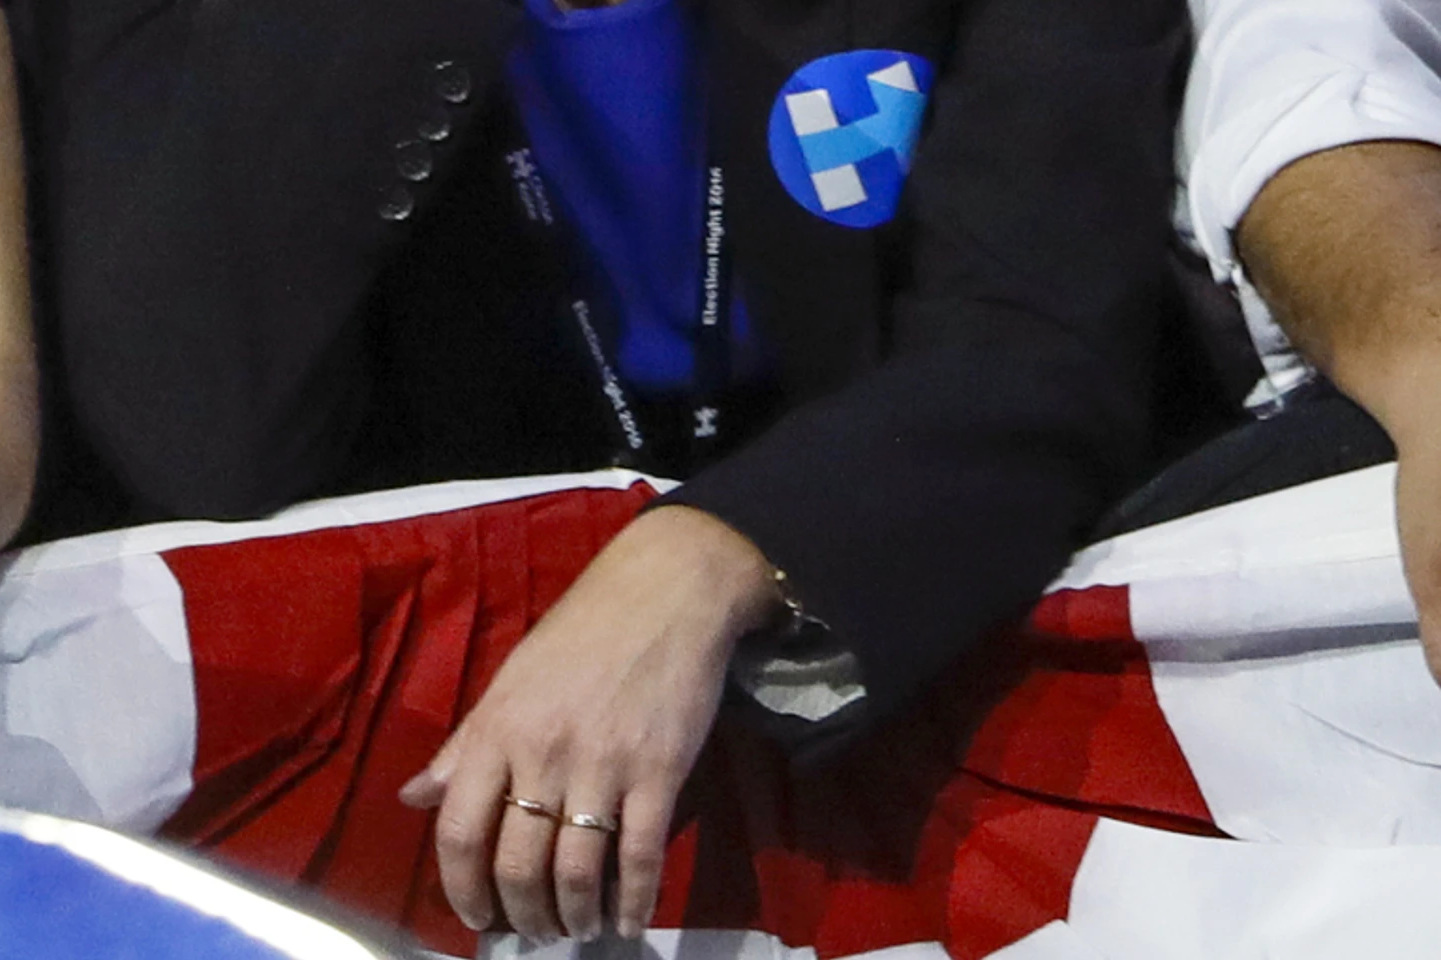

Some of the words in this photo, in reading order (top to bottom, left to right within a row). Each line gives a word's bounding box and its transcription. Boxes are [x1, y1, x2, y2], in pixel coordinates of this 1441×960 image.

[706, 210, 725, 255] Night
[702, 257, 720, 325] Election
[618, 409, 643, 449] 2016
